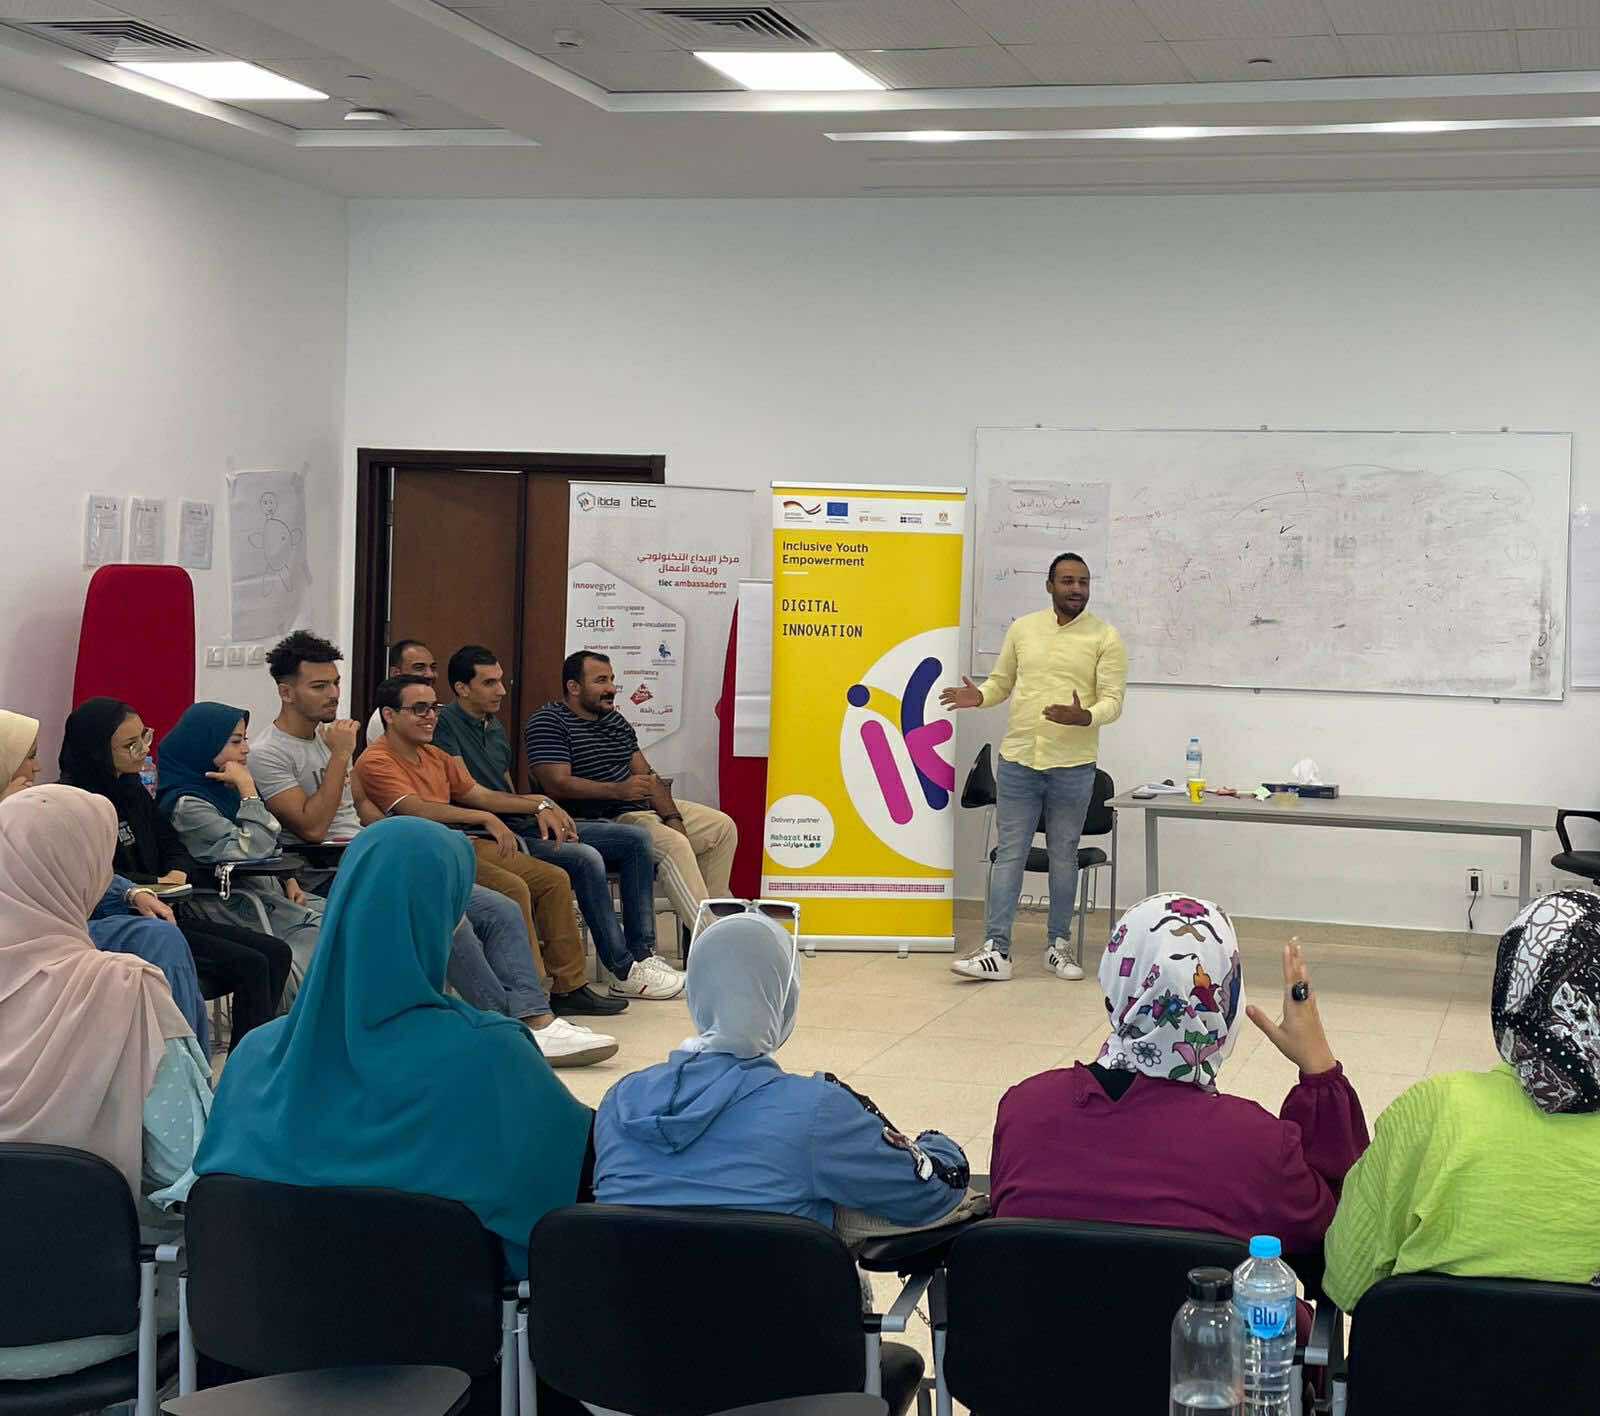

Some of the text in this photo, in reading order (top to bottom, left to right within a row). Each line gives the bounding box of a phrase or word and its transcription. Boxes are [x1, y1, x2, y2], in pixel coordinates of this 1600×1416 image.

[597, 496, 656, 508] itida tiec
[782, 541, 869, 553] Inclusive Youth
[690, 553, 717, 564] الإبداع
[718, 554, 740, 565] مركز
[782, 554, 865, 567] Empowerment
[658, 563, 718, 575] وريادة الأعمال
[573, 582, 616, 591] innovegypt
[674, 580, 727, 589] ambassadors
[782, 599, 838, 613] DIGITAL
[576, 617, 615, 628] startit
[782, 624, 864, 638] INNOVATION
[770, 816, 796, 824] Delivery
[770, 833, 821, 841] Maharat Misr
[1252, 1307, 1278, 1326] Blu
